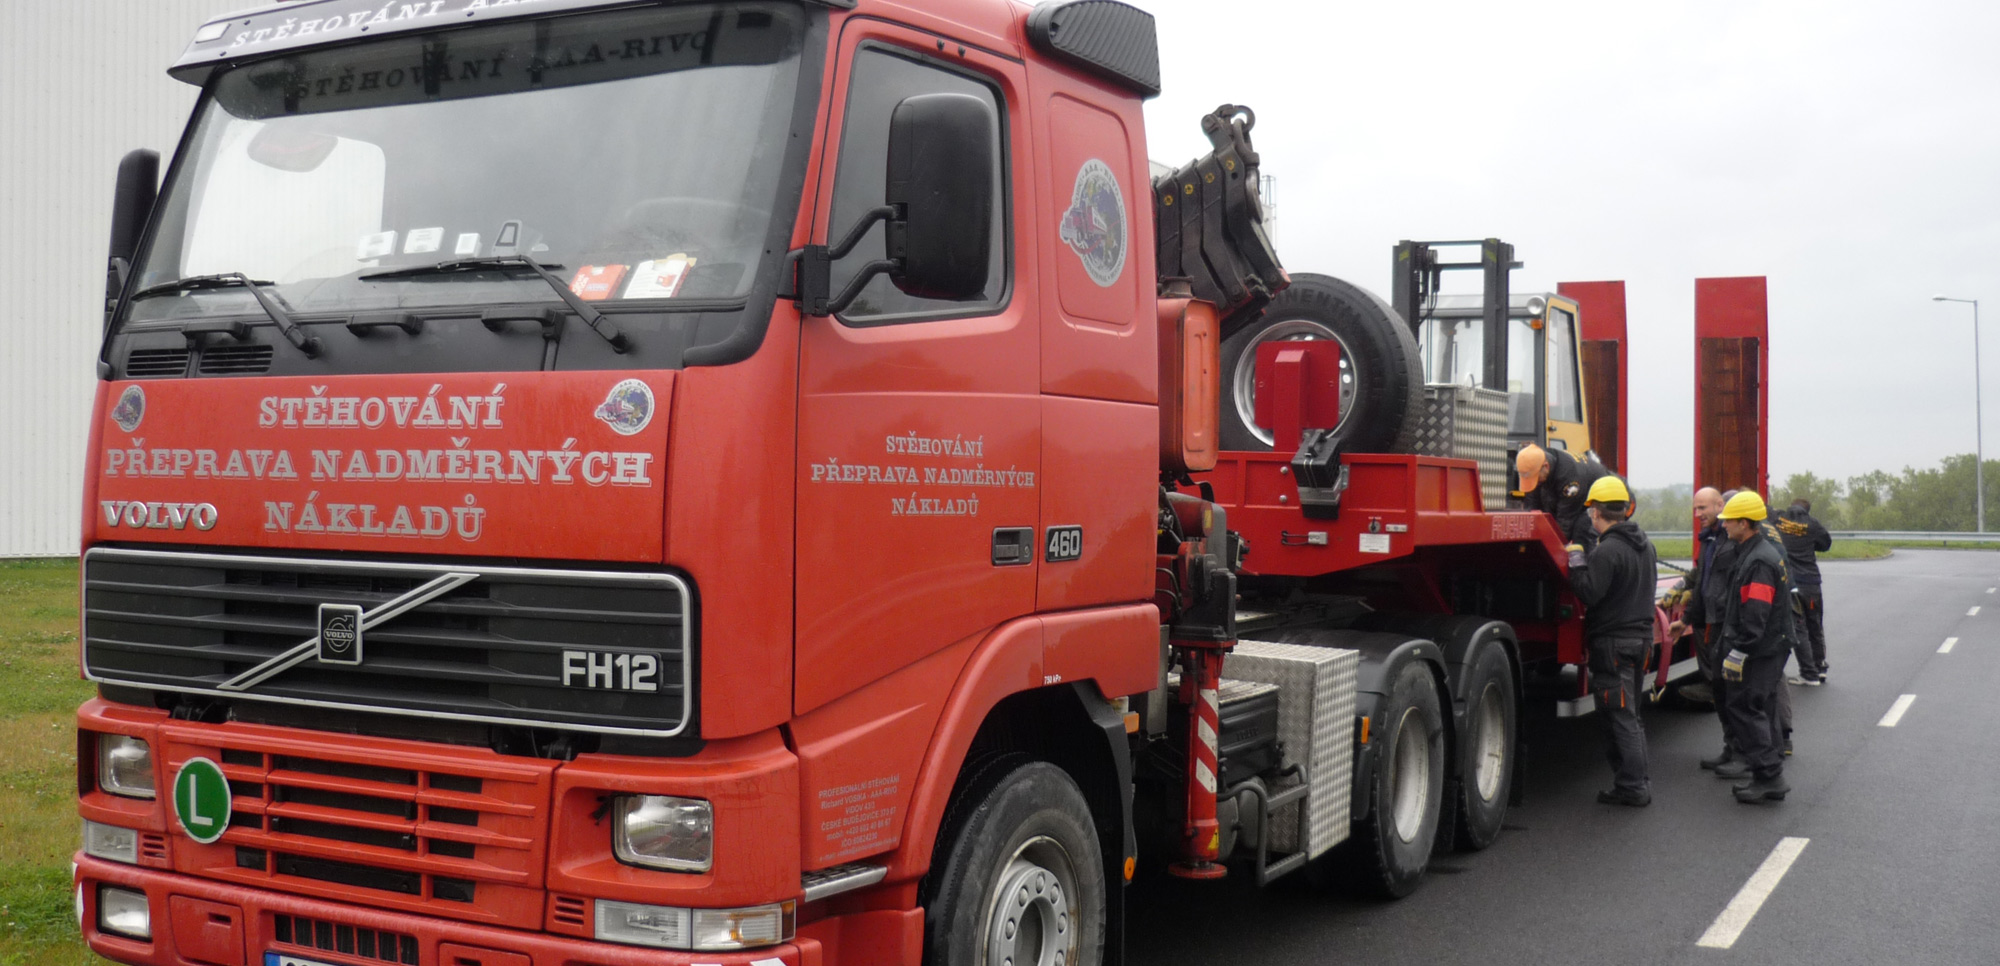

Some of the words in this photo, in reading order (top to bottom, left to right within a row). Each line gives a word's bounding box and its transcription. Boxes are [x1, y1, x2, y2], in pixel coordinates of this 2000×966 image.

[259, 383, 505, 429] STĚHOVÁNÍ
[886, 430, 984, 457] STĚHOVÁNÍ
[105, 437, 297, 480] PŘEPRAVA
[310, 436, 654, 488] NADMĚRNÝCH
[811, 457, 919, 484] PŘEPRAVA
[923, 463, 1035, 488] NADMĚRNÝCH
[101, 501, 218, 531] VOLVO
[264, 491, 485, 541] NÁKLADŮ
[891, 492, 979, 516] NÁKLADŮ
[1049, 530, 1081, 556] 460
[325, 631, 353, 639] VOLVO
[562, 651, 658, 692] FH12
[188, 774, 212, 825] L
[821, 799, 844, 810] Richard
